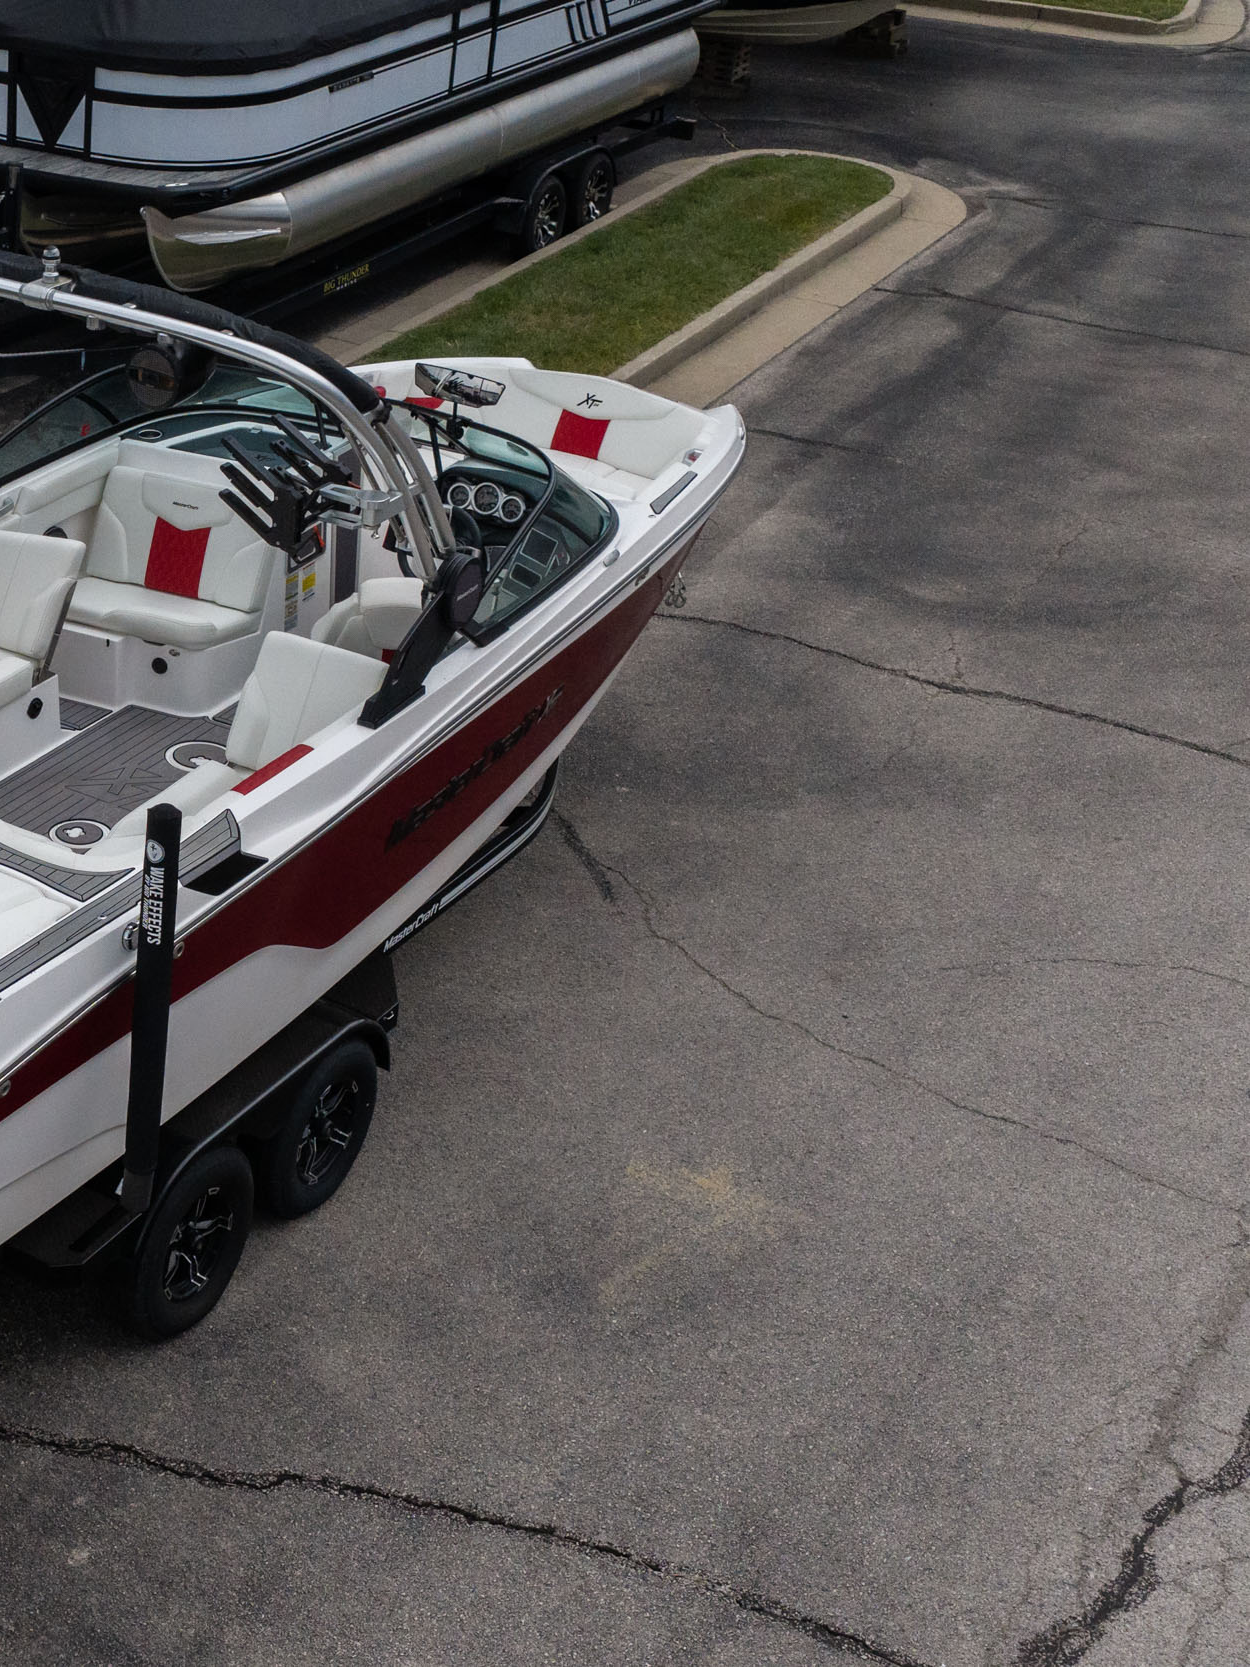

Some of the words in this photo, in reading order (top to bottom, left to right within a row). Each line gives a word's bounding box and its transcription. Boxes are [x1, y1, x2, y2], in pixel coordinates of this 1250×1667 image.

[337, 263, 369, 287] THUNDER
[150, 866, 165, 898] WAKE
[147, 899, 164, 945] EFFECTS
